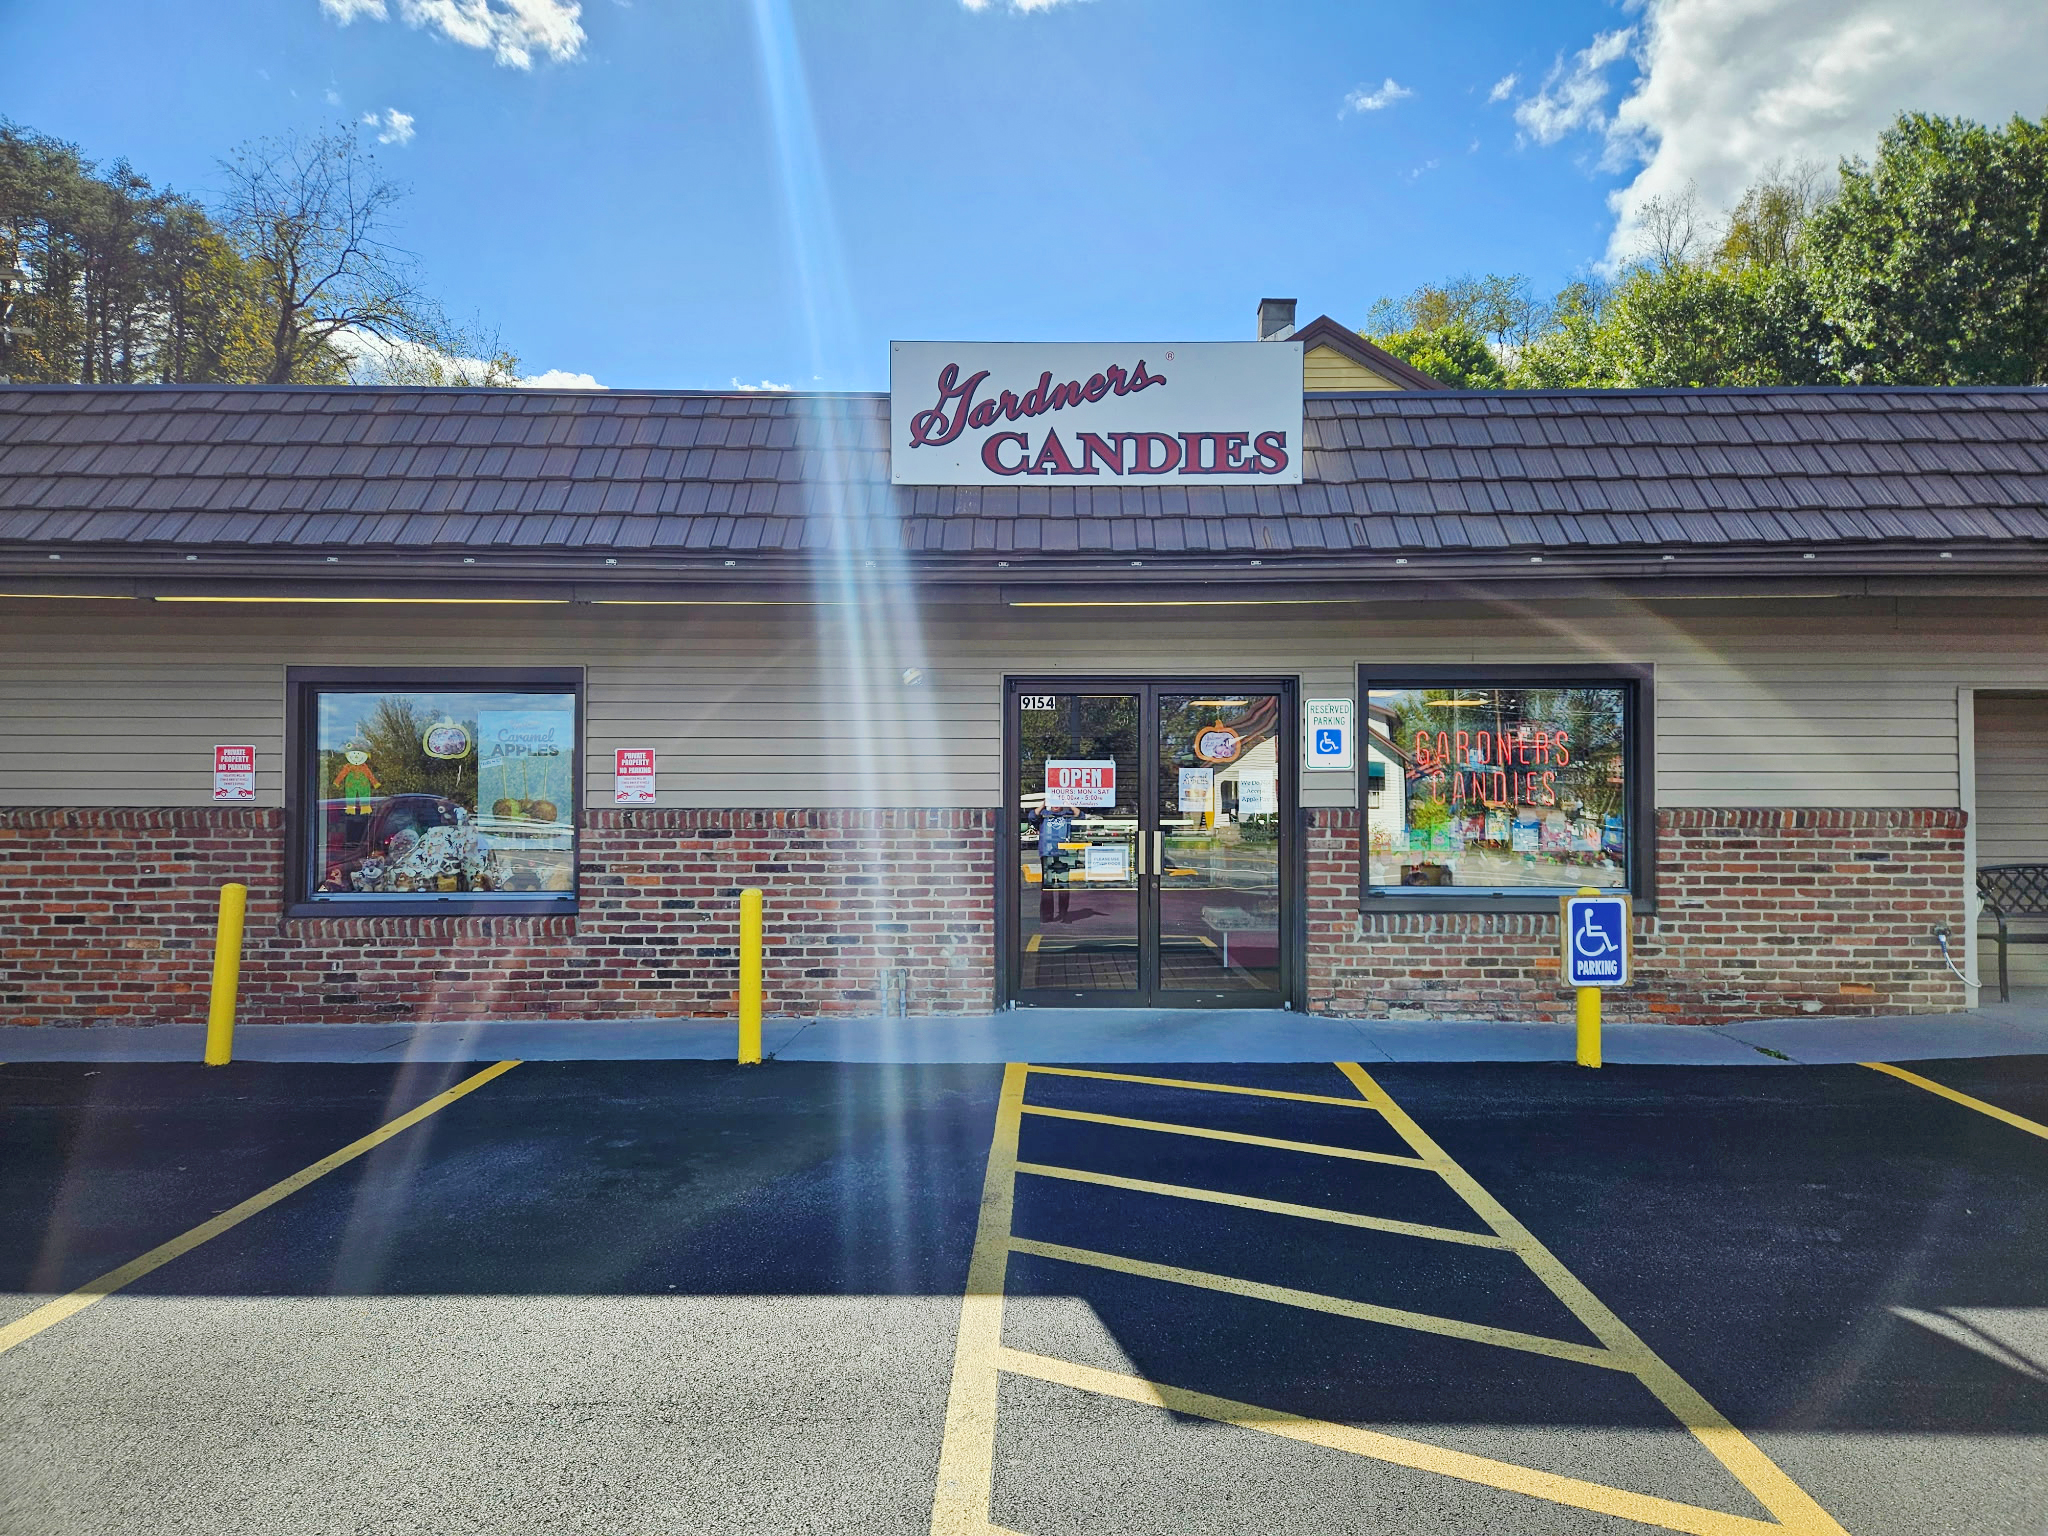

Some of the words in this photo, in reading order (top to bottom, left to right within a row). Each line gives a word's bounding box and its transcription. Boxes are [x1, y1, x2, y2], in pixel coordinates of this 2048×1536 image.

[909, 359, 1166, 448] Gardners
[981, 427, 1289, 475] CANDIES
[1022, 696, 1054, 709] 9154
[1310, 704, 1350, 714] RESERVED
[1313, 716, 1346, 726] PARKING
[498, 727, 555, 743] Caramel
[223, 748, 246, 756] PRIVATE
[491, 743, 560, 757] APPLES
[1415, 730, 1570, 767] GARDNERS
[220, 755, 249, 763] PROPERTY
[218, 763, 226, 771] NO
[227, 763, 251, 771] PARKING
[619, 766, 627, 774] NO
[628, 766, 652, 774] PARKING
[1059, 768, 1102, 788] OPEN
[1432, 769, 1556, 806] CANDIES
[1577, 960, 1618, 976] PARKING
